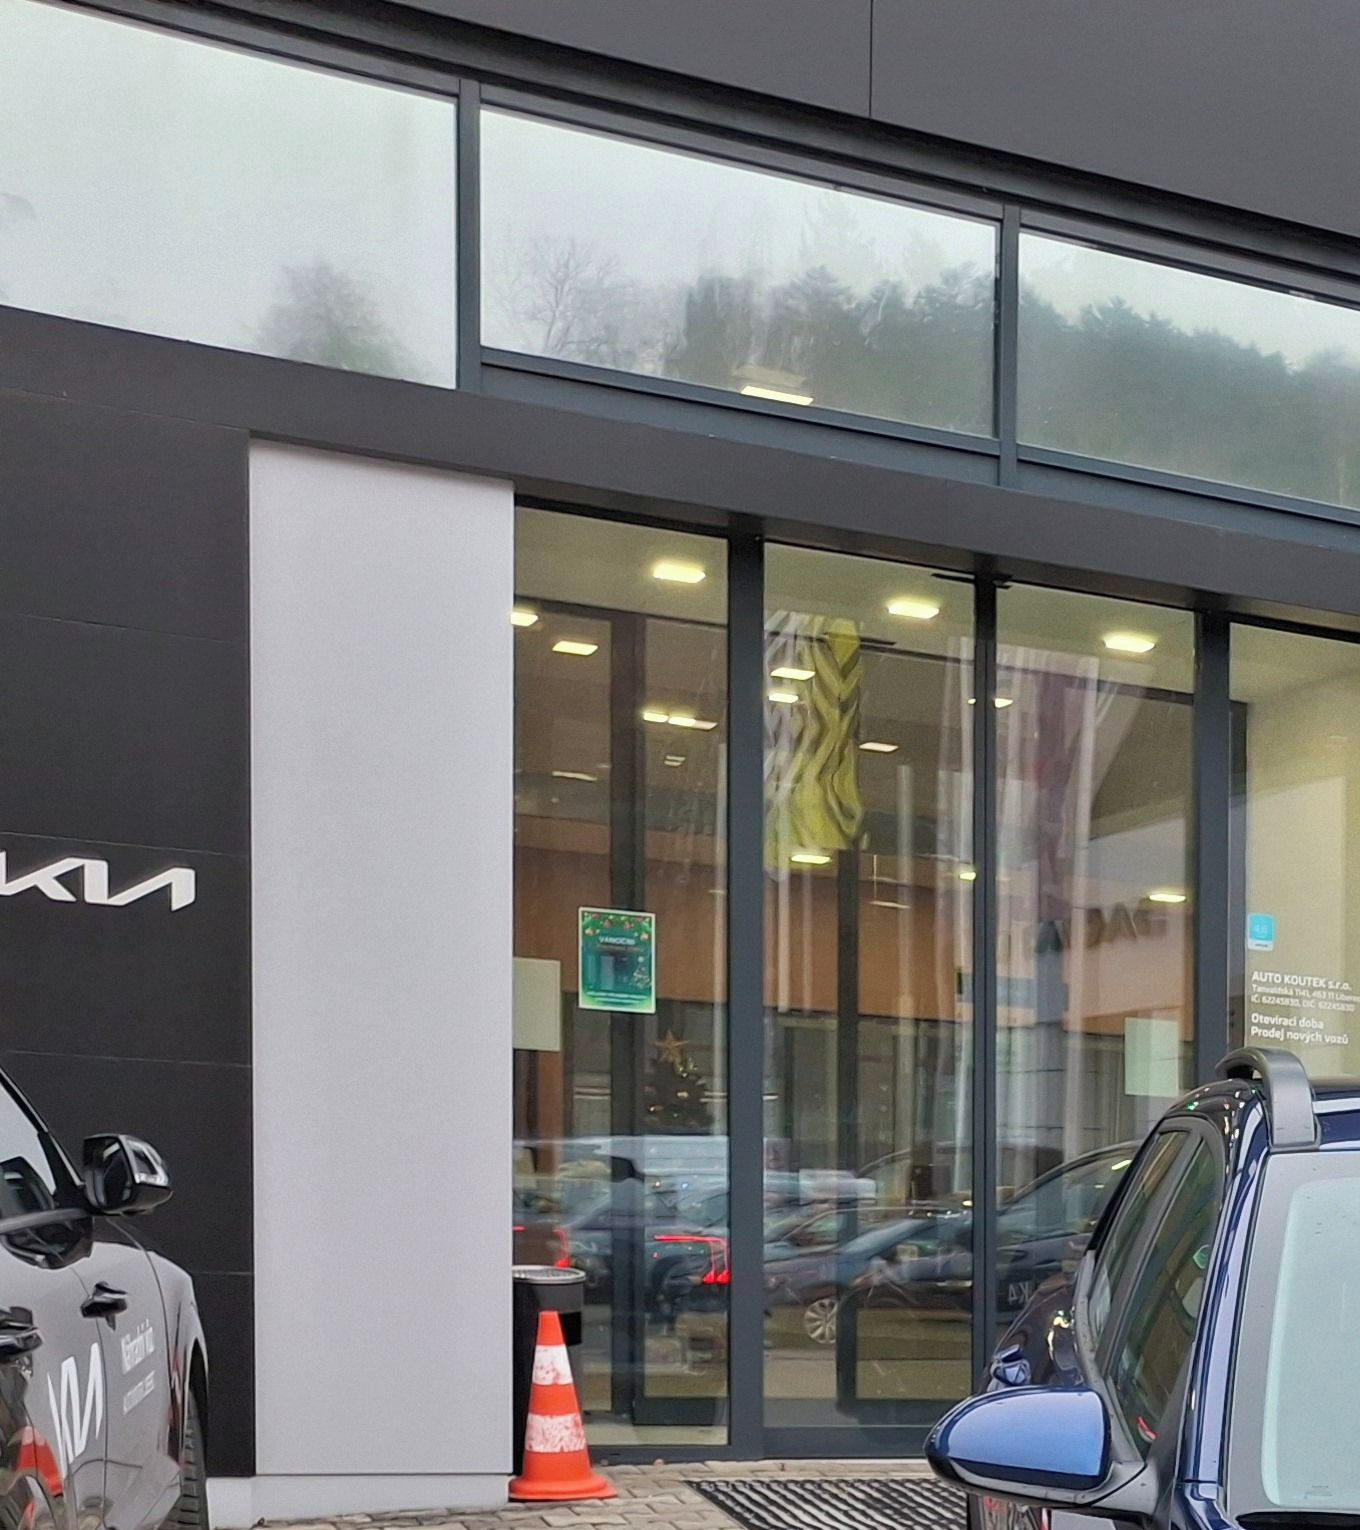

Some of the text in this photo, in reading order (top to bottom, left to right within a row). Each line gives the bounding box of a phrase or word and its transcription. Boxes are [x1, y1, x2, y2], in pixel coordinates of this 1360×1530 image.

[0, 850, 196, 912] KIA
[1252, 971, 1352, 990] AUTO KOUTEK s.r.o.
[1251, 1013, 1324, 1029] Otevírací doba
[1251, 1026, 1349, 1044] Prodej nových vozů
